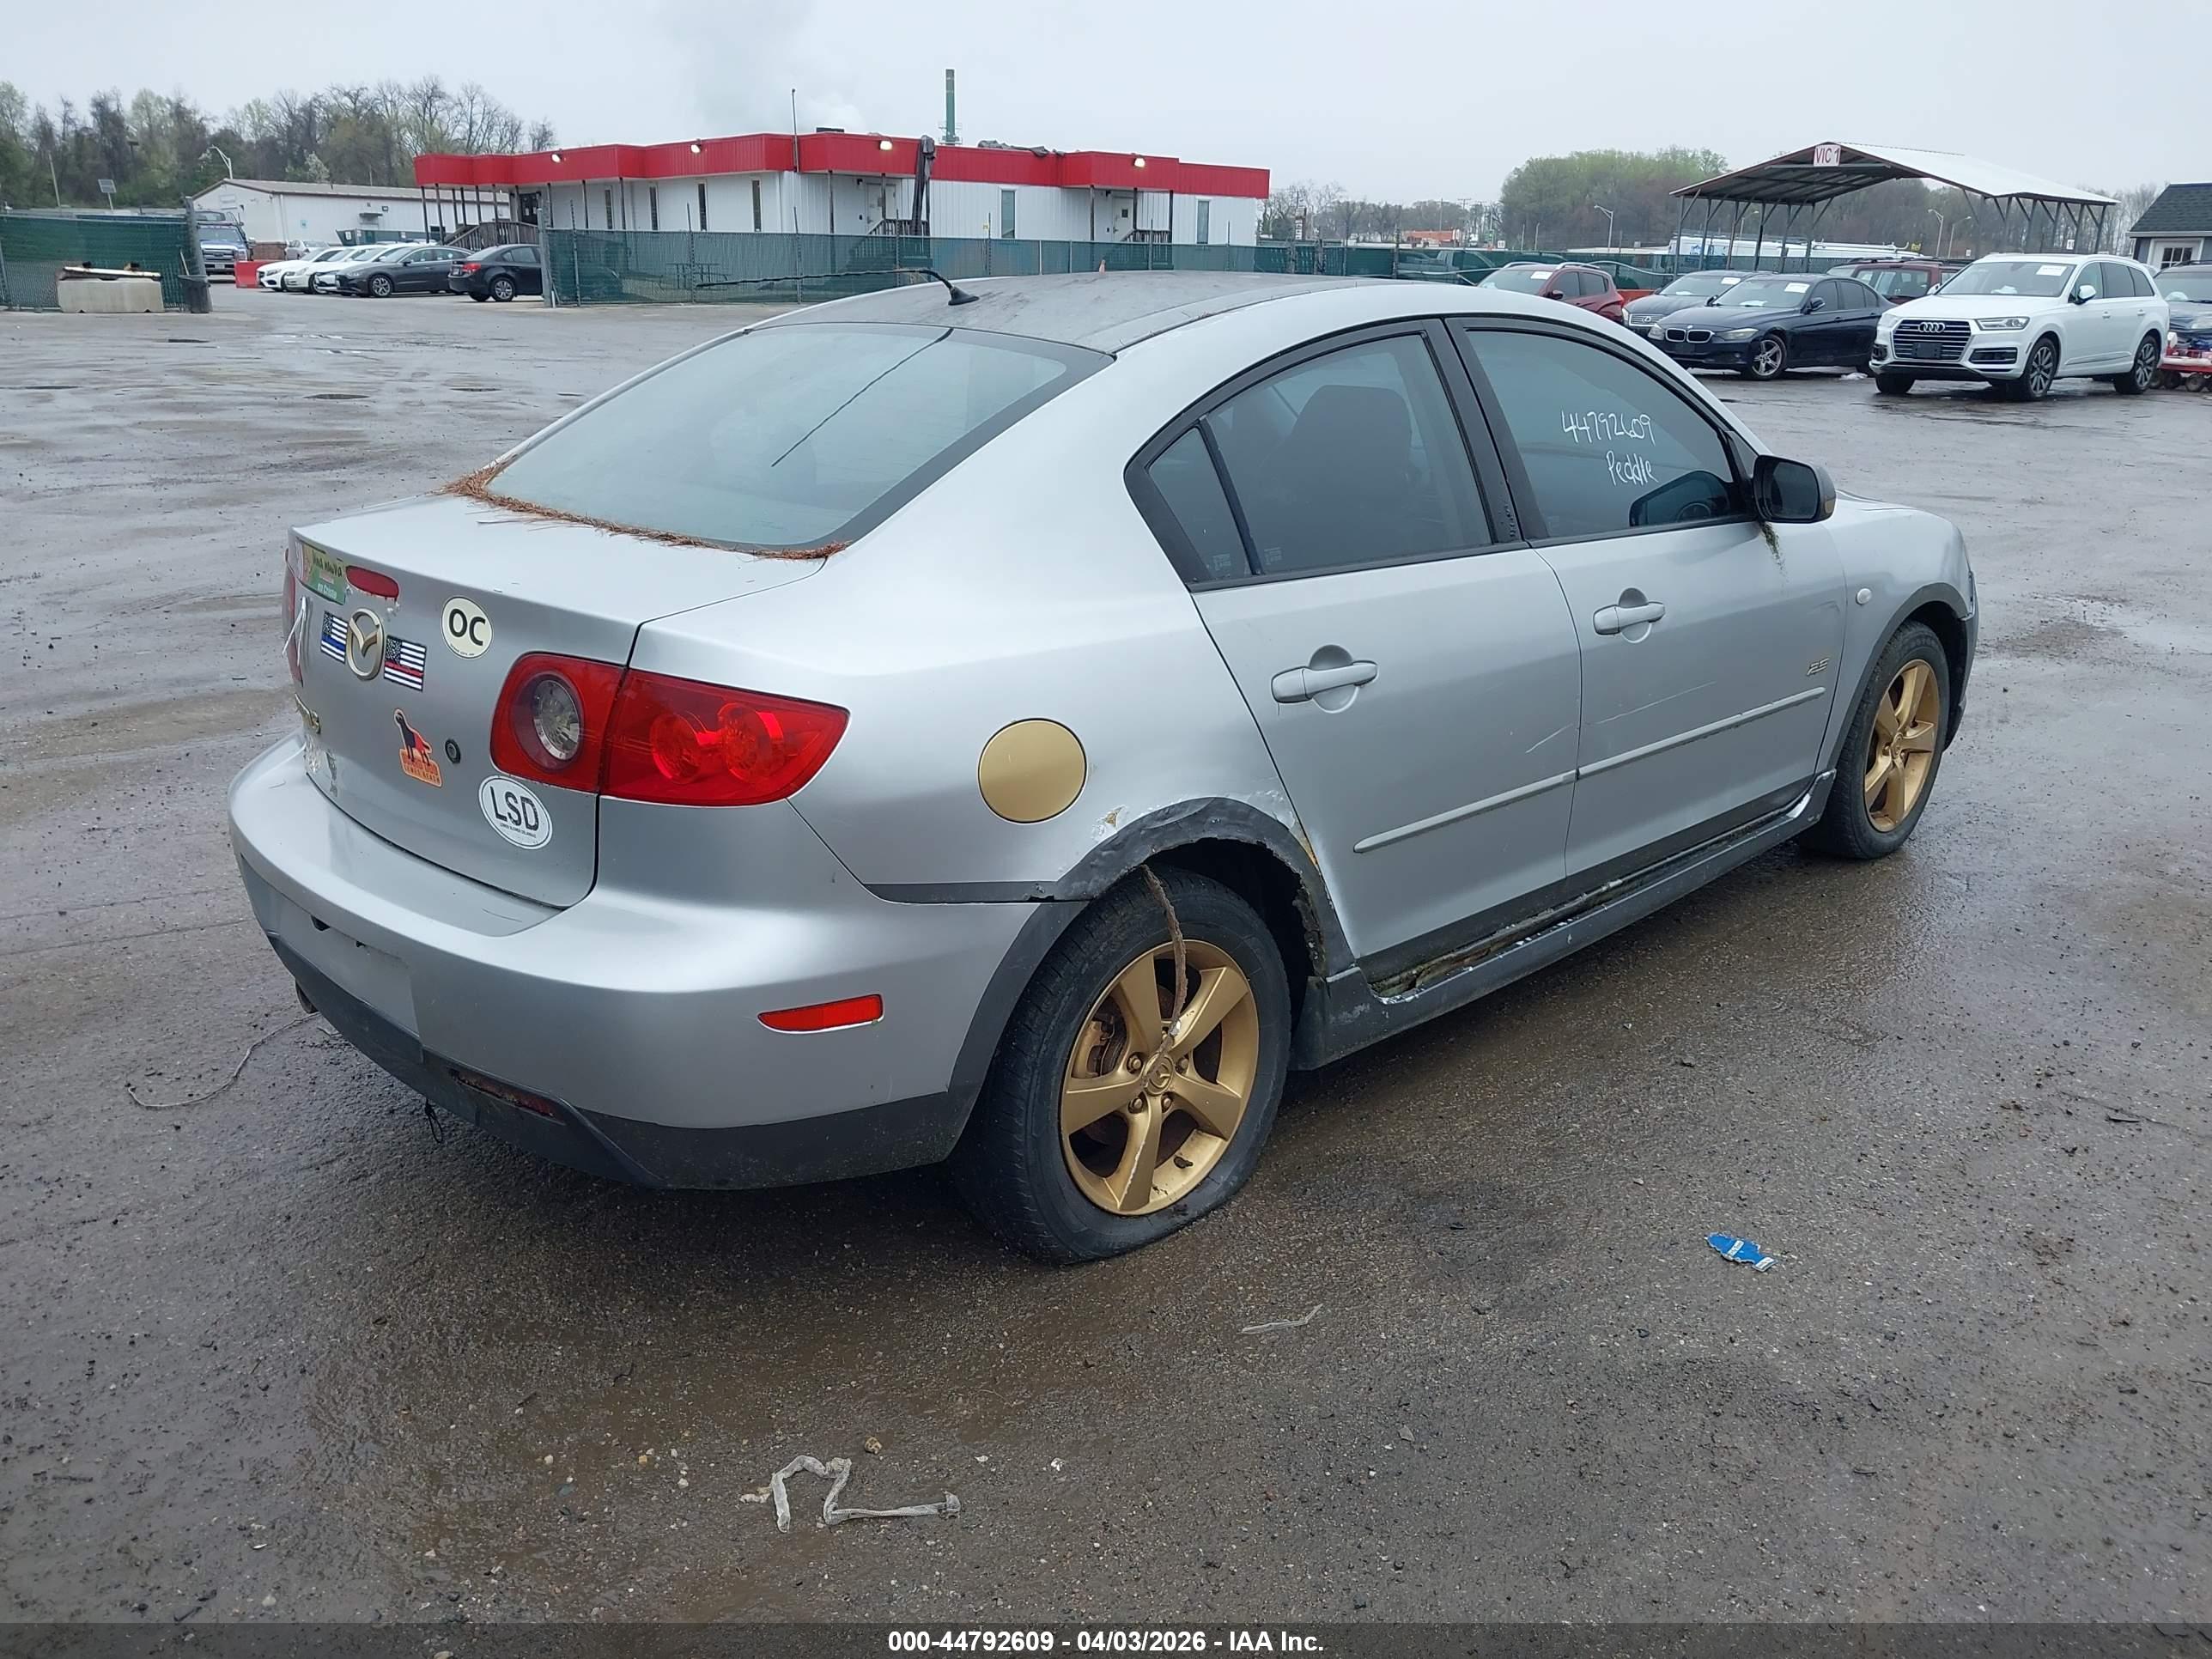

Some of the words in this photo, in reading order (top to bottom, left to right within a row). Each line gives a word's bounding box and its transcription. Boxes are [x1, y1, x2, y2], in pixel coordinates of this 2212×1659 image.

[1816, 148, 1832, 163] VIC
[1834, 148, 1839, 163] 1
[1561, 410, 1656, 446] 44792609
[1606, 450, 1659, 485] Peddle
[449, 608, 486, 646] OC
[490, 786, 539, 831] LSD
